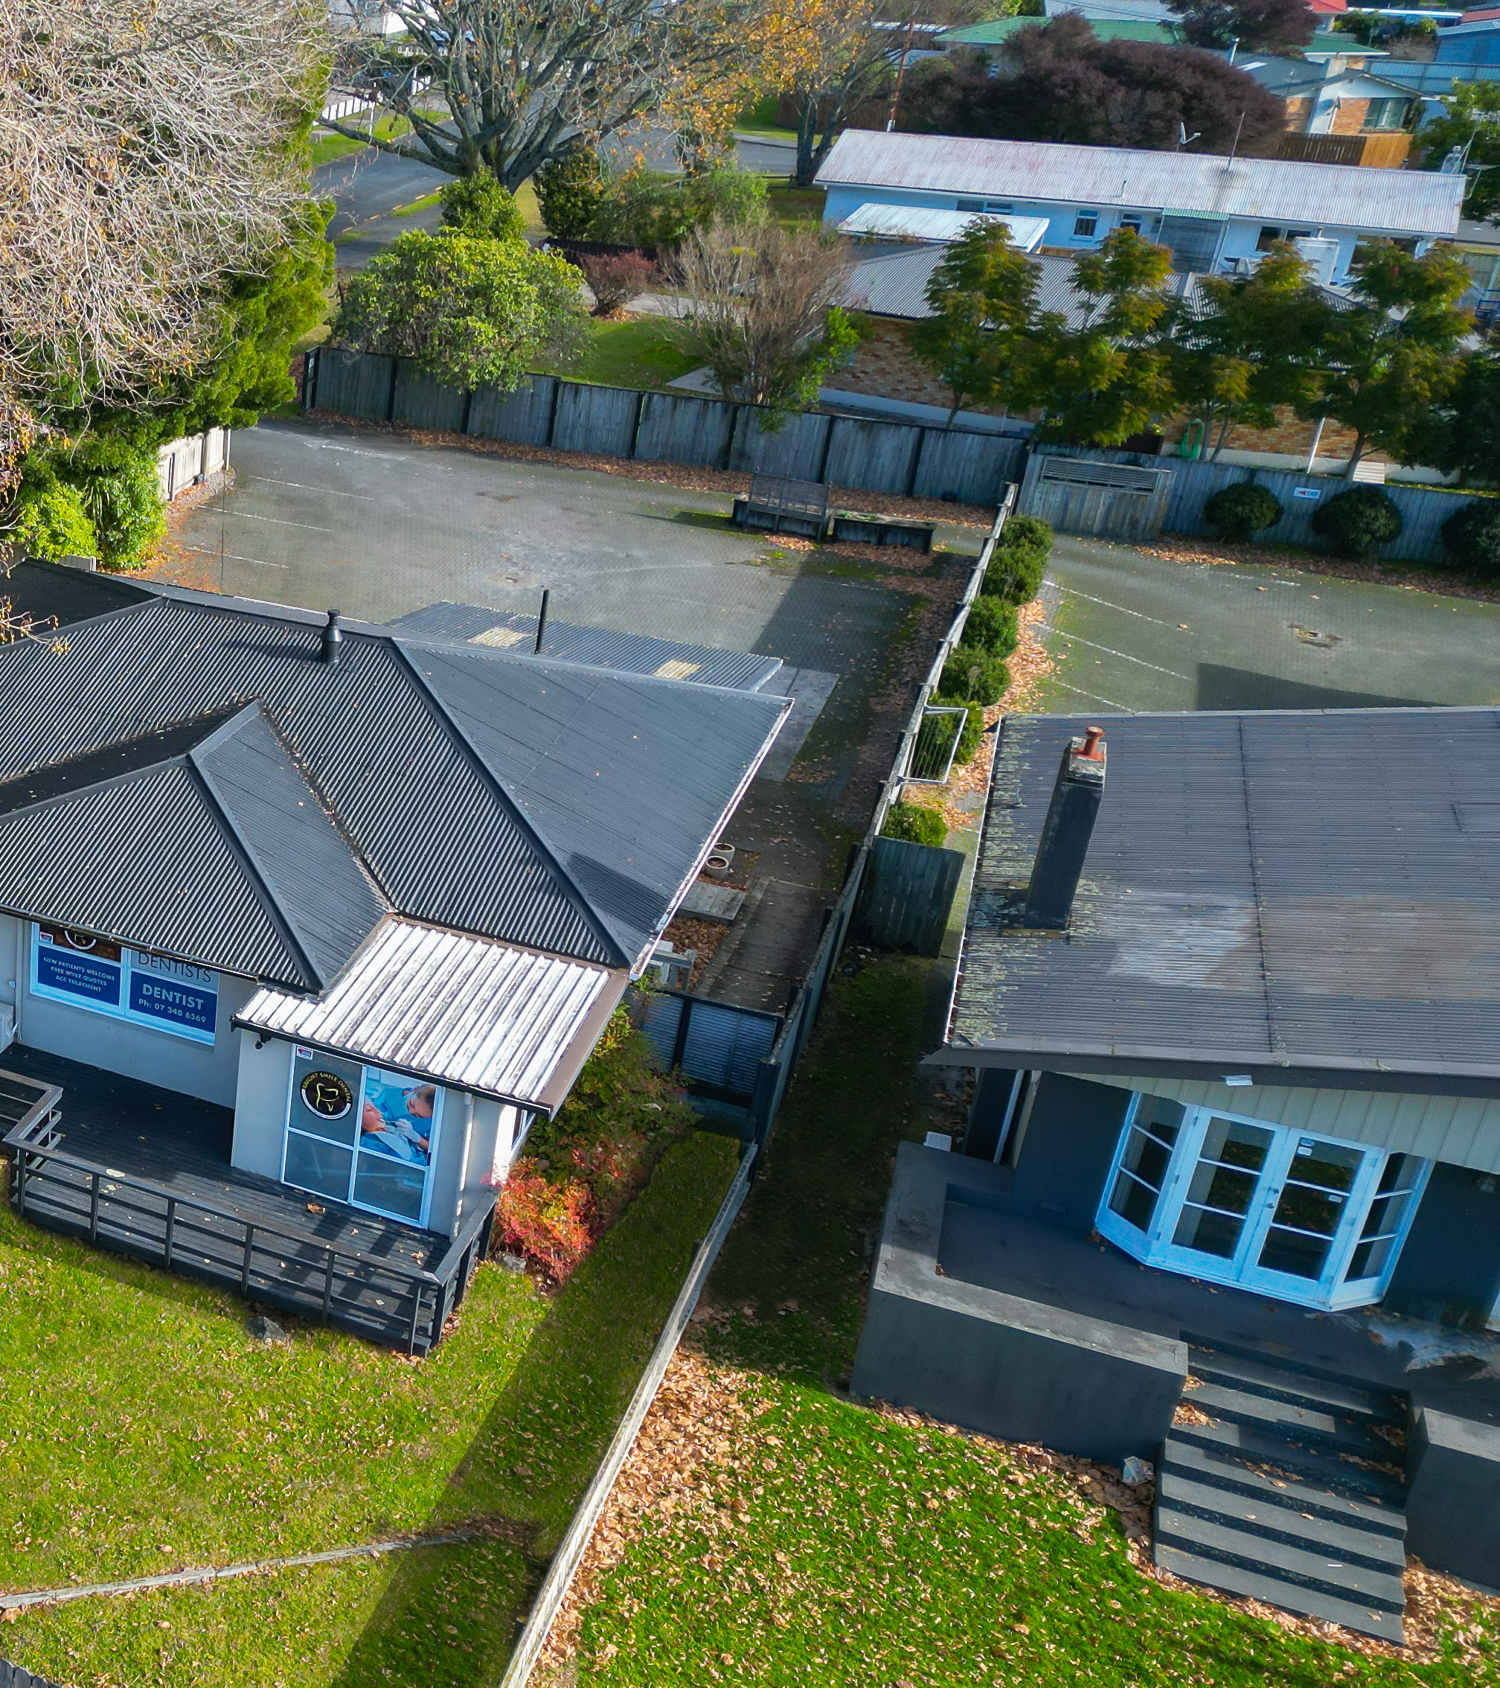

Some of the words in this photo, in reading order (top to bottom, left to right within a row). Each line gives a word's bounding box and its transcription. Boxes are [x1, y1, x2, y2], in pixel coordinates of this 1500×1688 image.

[43, 957, 57, 965] NEW
[58, 961, 85, 973] PATIENTS
[86, 969, 115, 981] WELCOME
[51, 966, 64, 974] FREE
[83, 975, 107, 986] QUOTES
[139, 952, 211, 983] DENTISTS
[142, 983, 204, 1010] DENTIST
[155, 1003, 165, 1011] 07
[185, 1012, 206, 1023] 6569
[320, 1072, 338, 1081] SMILE
